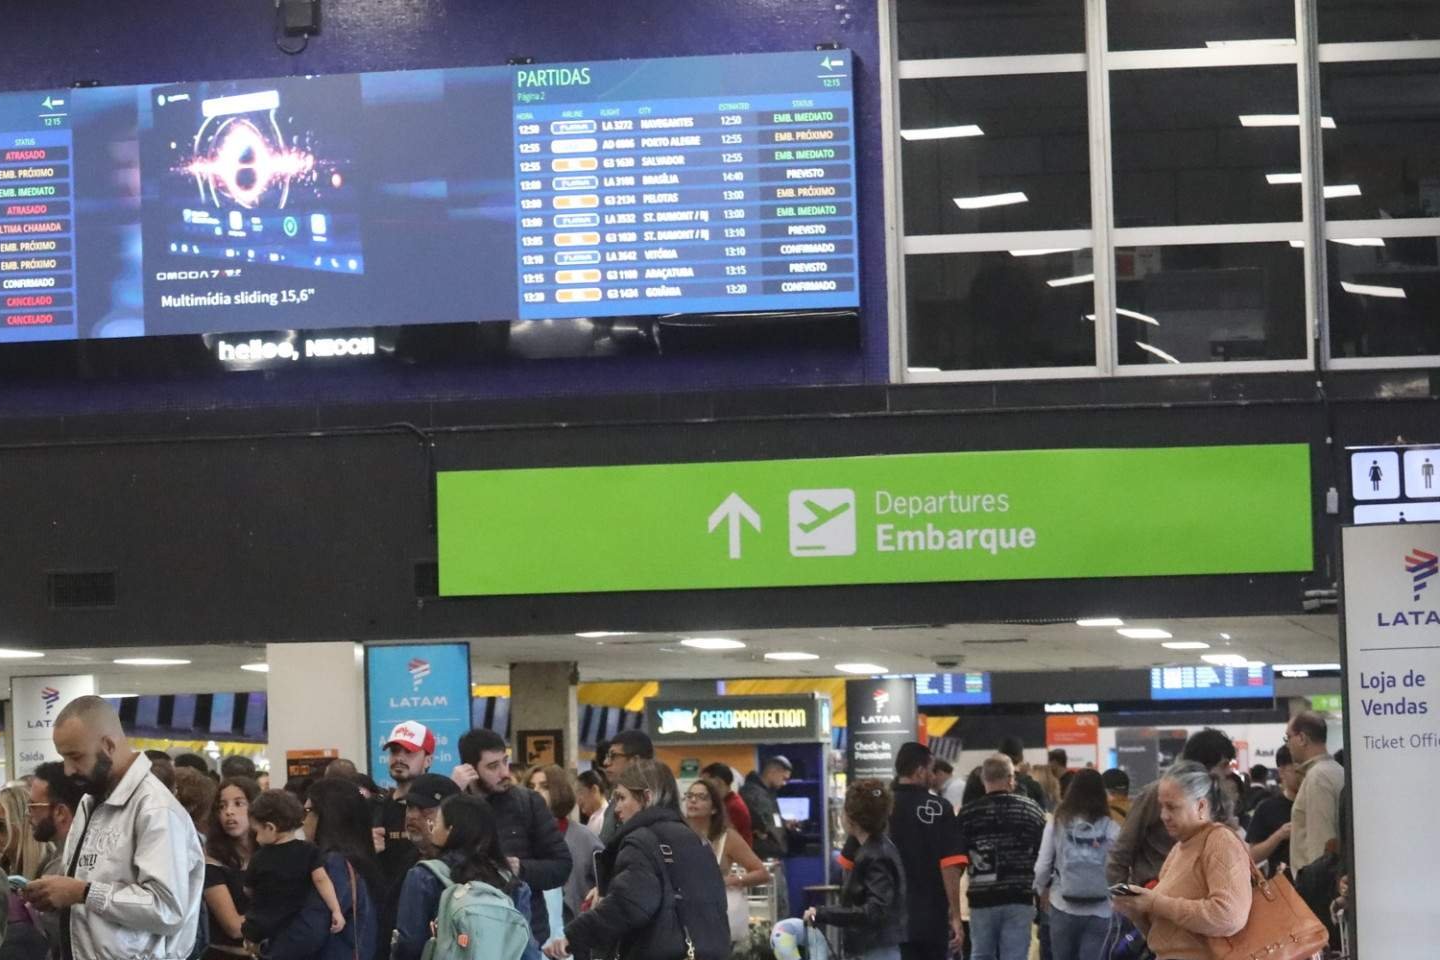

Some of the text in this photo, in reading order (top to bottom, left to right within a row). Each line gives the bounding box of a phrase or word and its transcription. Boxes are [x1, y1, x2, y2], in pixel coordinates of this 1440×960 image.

[518, 68, 591, 87] PARTIDAS
[641, 118, 693, 128] NAVEGANTES
[721, 116, 741, 125] 12:50
[774, 114, 792, 122] EMB.
[795, 112, 833, 121] IMEDIATO
[15, 138, 36, 146] STATUS
[641, 138, 669, 147] PORTO
[670, 136, 700, 146] ALEGRE
[722, 134, 742, 143] 12:55
[775, 132, 794, 141] EMB.
[796, 130, 833, 140] PRÓXIMO
[6, 151, 45, 160] ATRASADO
[642, 156, 684, 166] SALVADOR
[722, 153, 742, 162] 12:55
[775, 151, 794, 160] EMB.
[796, 150, 834, 159] IMEDIATO
[0, 170, 17, 179] EMB.
[18, 167, 53, 177] PRÓXIMO
[723, 172, 743, 181] 14:40
[787, 169, 824, 178] PREVISTO
[0, 189, 17, 197] EMB.
[18, 187, 55, 196] IMEDIATO
[643, 186, 835, 203] PELOTAS 13:00 EMB. PRÓXIMO
[7, 205, 47, 214] ATRASADO
[724, 209, 744, 218] 13:00
[777, 207, 796, 216] EMB.
[797, 206, 836, 215] IMEDIATO
[23, 223, 61, 232] CHAMADA
[724, 228, 745, 237] 13:10
[788, 225, 826, 234] PREVISTO
[0, 243, 17, 252] EMB.
[20, 240, 55, 250] PRÓXIMO
[725, 247, 746, 256] 13:10
[780, 244, 835, 253] CONFIRMADO
[1, 262, 19, 270] EMB.
[20, 259, 56, 269] PRÓXIMO
[726, 266, 746, 275] 13:15
[790, 262, 827, 272] PREVISTO
[3, 278, 54, 288] CONFIRMADO
[646, 281, 836, 297] GOIÂNIA 13:20 CONFIRMADO
[7, 296, 52, 306] CANCELADO
[161, 291, 231, 307] Multimídia
[234, 290, 278, 306] sliding
[7, 315, 53, 324] CANCELADO
[876, 490, 1009, 518] Departures
[876, 523, 1036, 554] Embarque
[1377, 610, 1440, 627] LATA
[1360, 669, 1426, 694] Loja de
[389, 695, 448, 708] LATAM
[1361, 697, 1428, 716] Vendas
[27, 719, 55, 729] LAT
[700, 708, 807, 730] AEROPROTECTION
[861, 714, 901, 724] LATAM
[854, 741, 891, 751] Check-in
[1363, 732, 1440, 750] Ticket Offi
